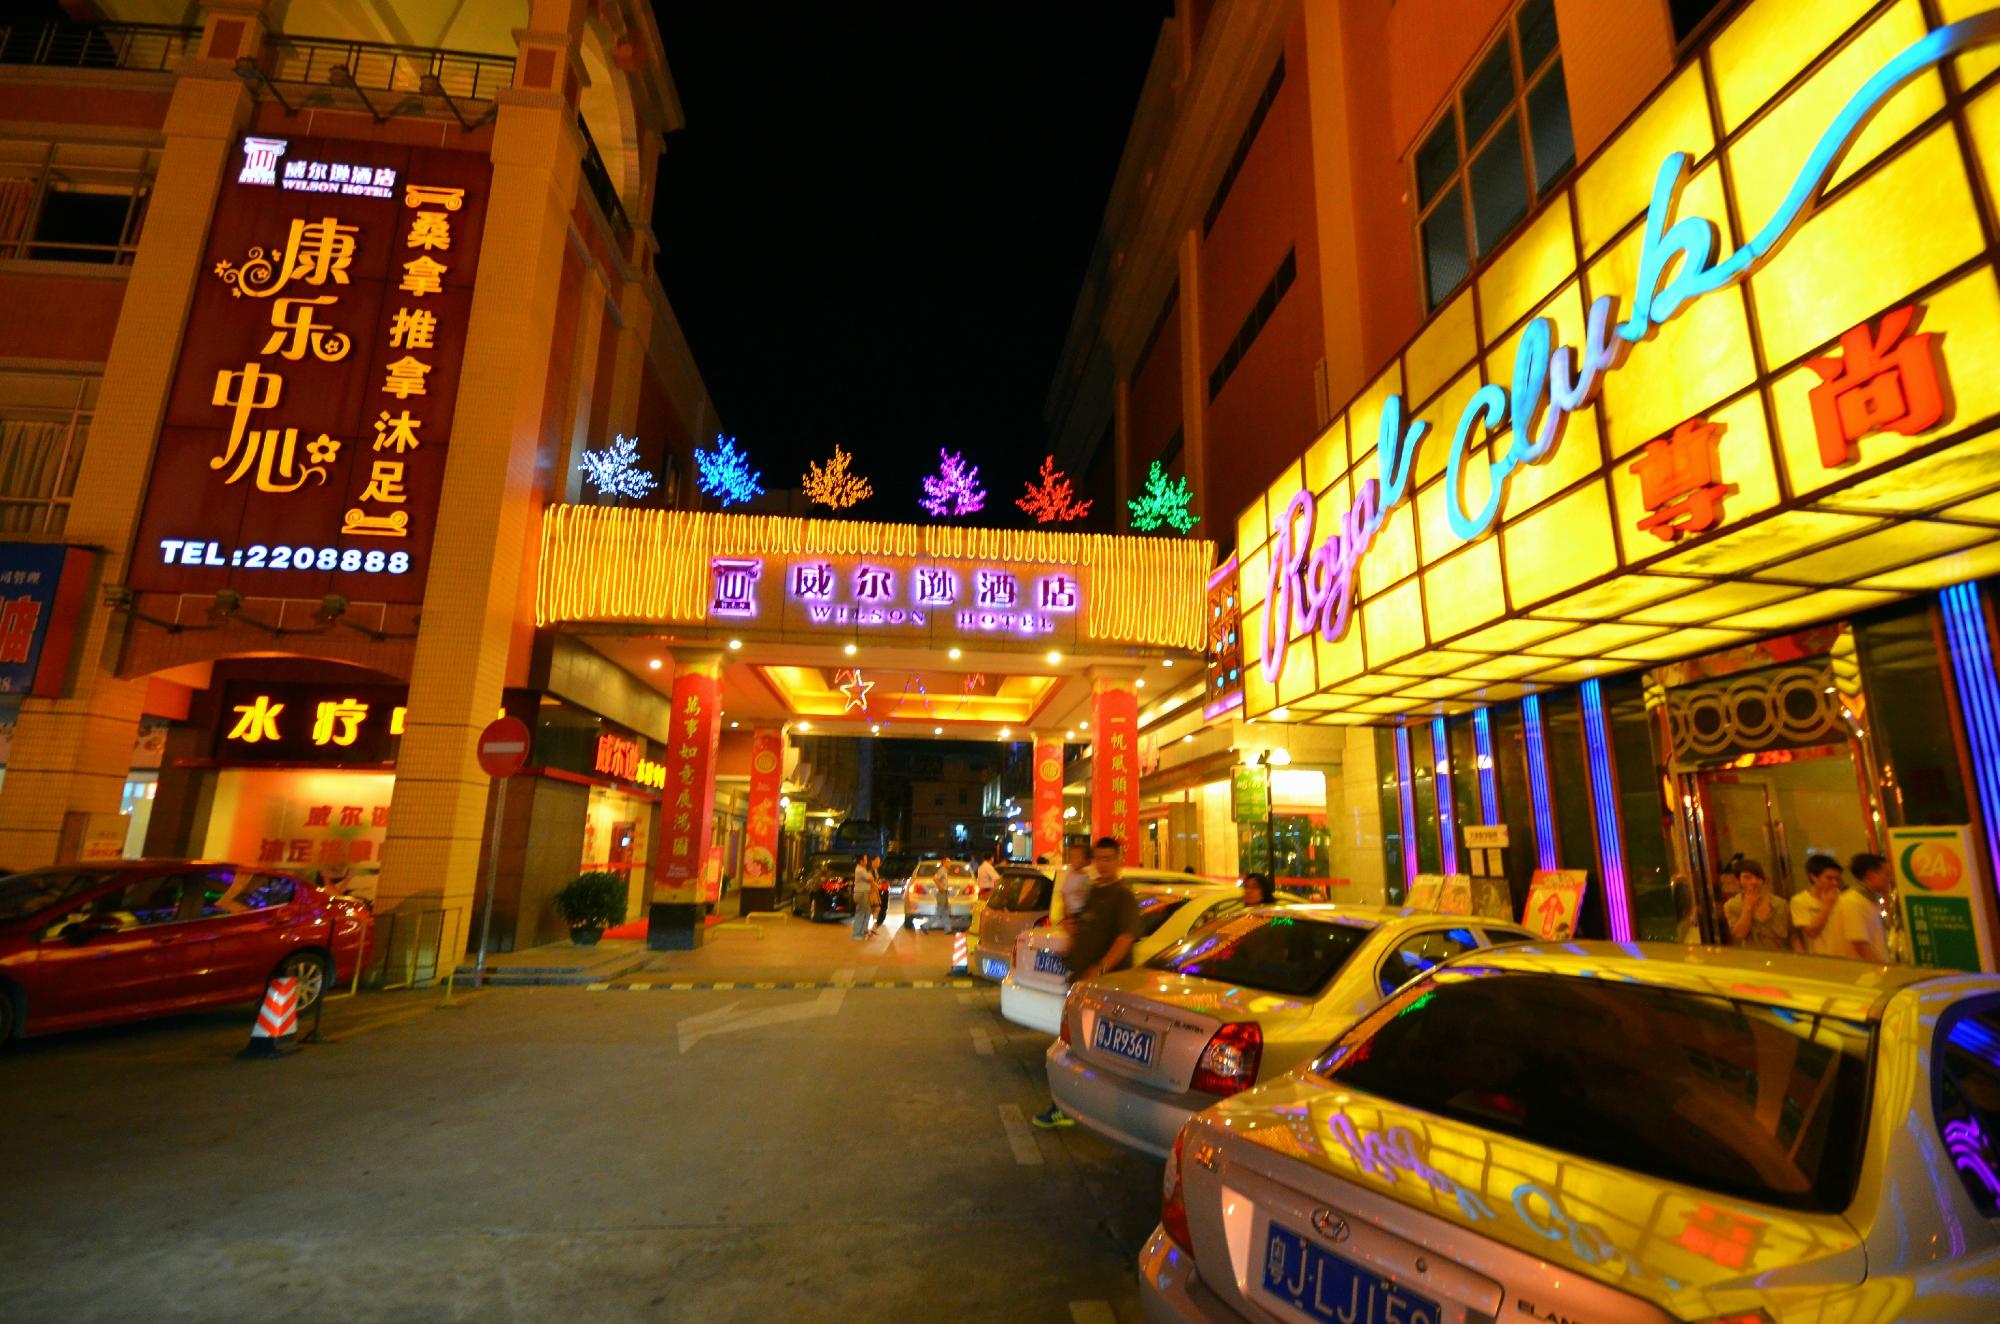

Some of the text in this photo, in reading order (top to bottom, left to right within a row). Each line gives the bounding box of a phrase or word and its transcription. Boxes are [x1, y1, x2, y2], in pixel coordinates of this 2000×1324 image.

[282, 179, 393, 198] WILSON HOTEL
[211, 217, 360, 493] 康乐中心
[360, 211, 451, 504] 桑拿推拿沐足
[160, 540, 410, 574] TEL:2208888
[1262, 394, 1428, 683] Royal
[795, 563, 1077, 608] 威尔逊酒店
[813, 605, 1054, 632] WILSON HOTEL
